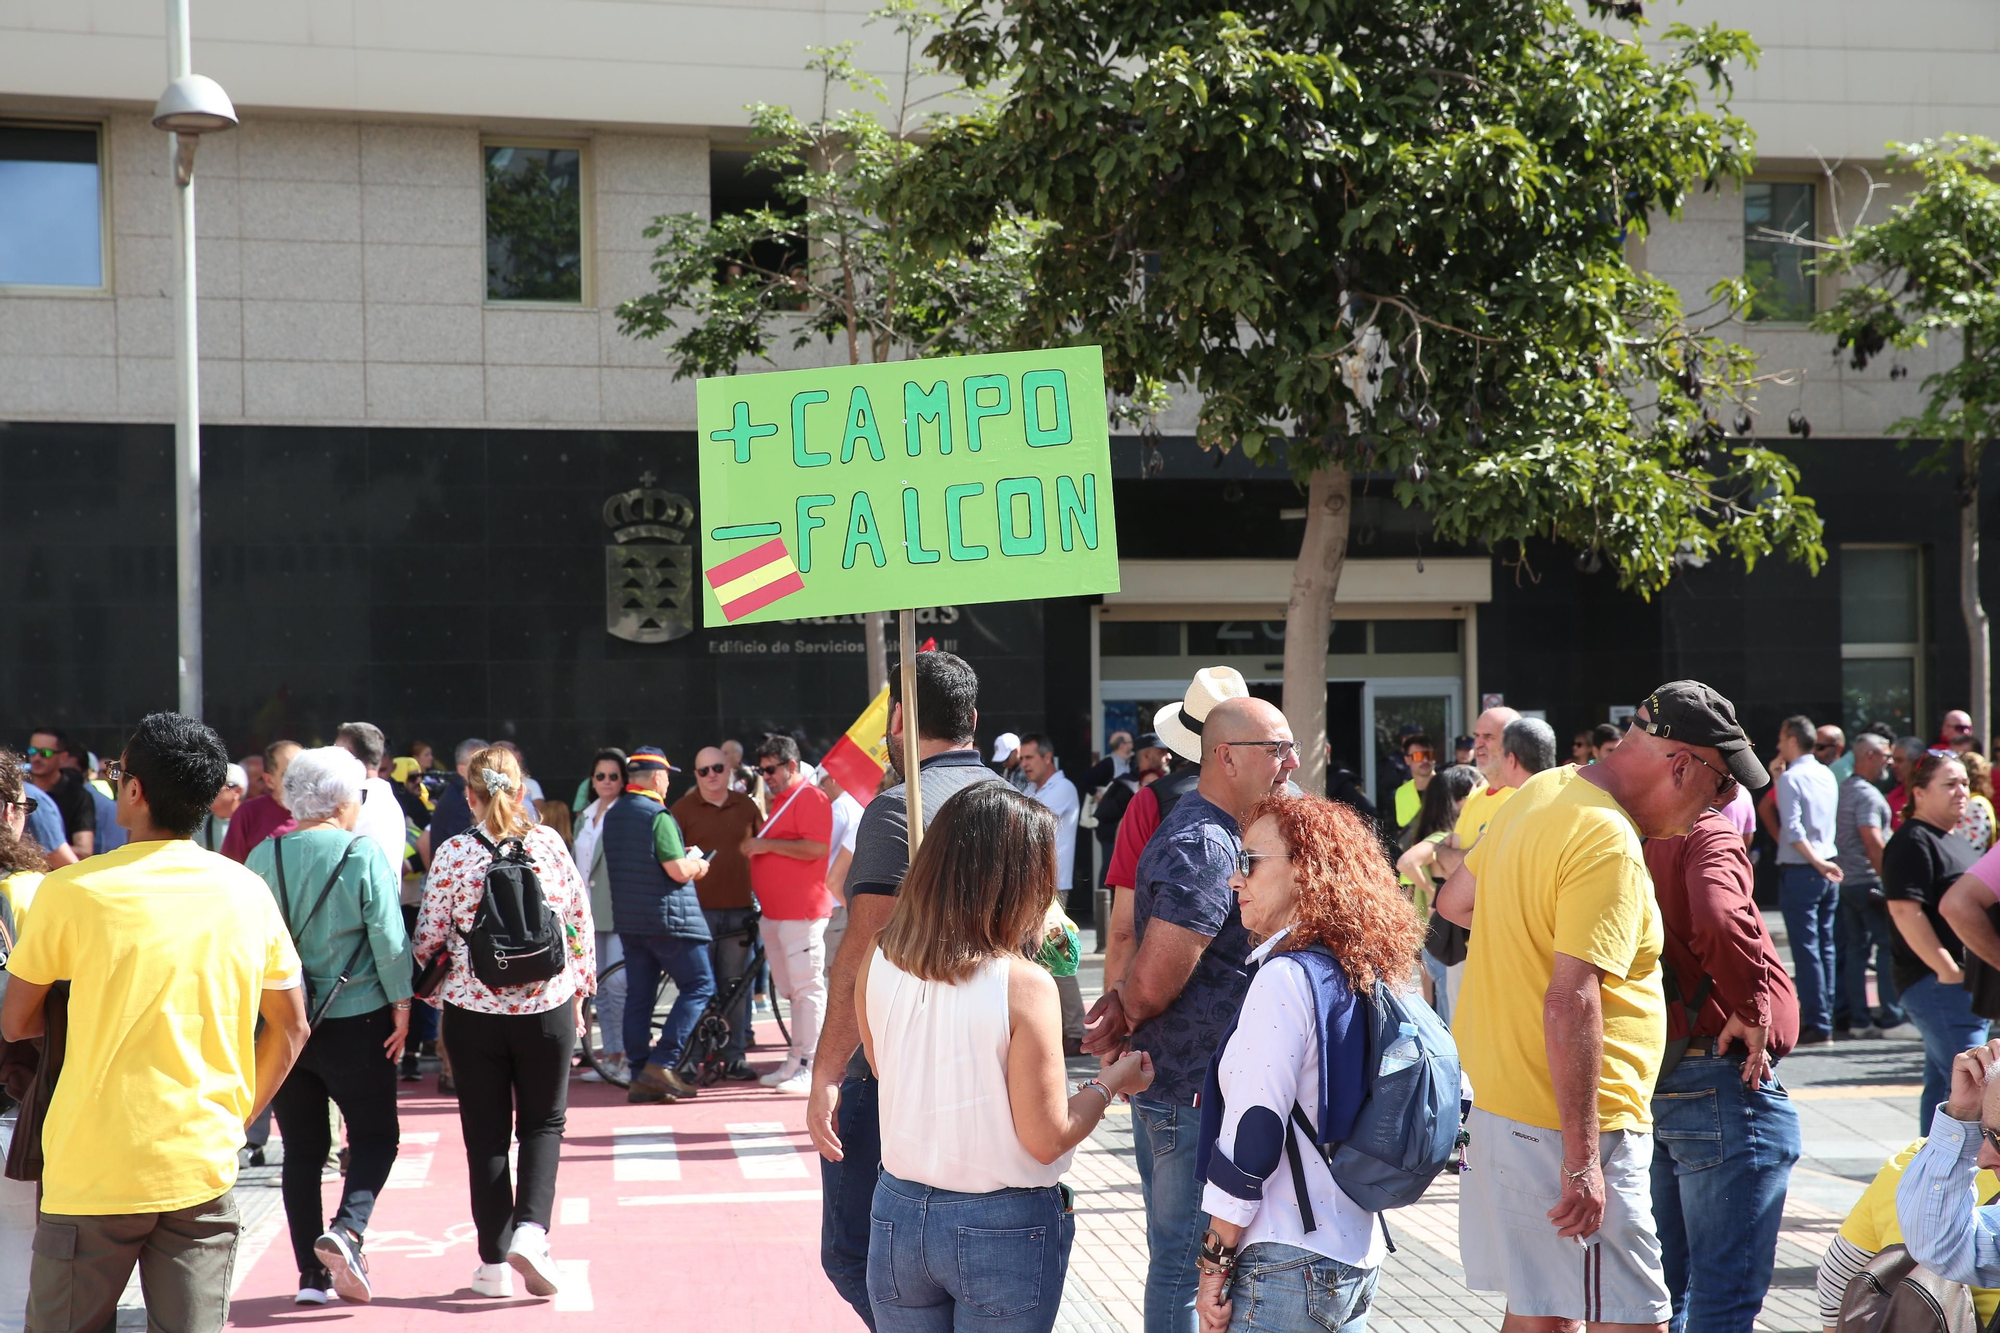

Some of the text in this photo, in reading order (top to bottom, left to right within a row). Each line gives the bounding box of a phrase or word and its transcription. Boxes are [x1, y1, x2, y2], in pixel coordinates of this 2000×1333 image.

[709, 640, 767, 653] Edificio
[771, 640, 790, 653] de
[794, 640, 865, 653] Servicios
